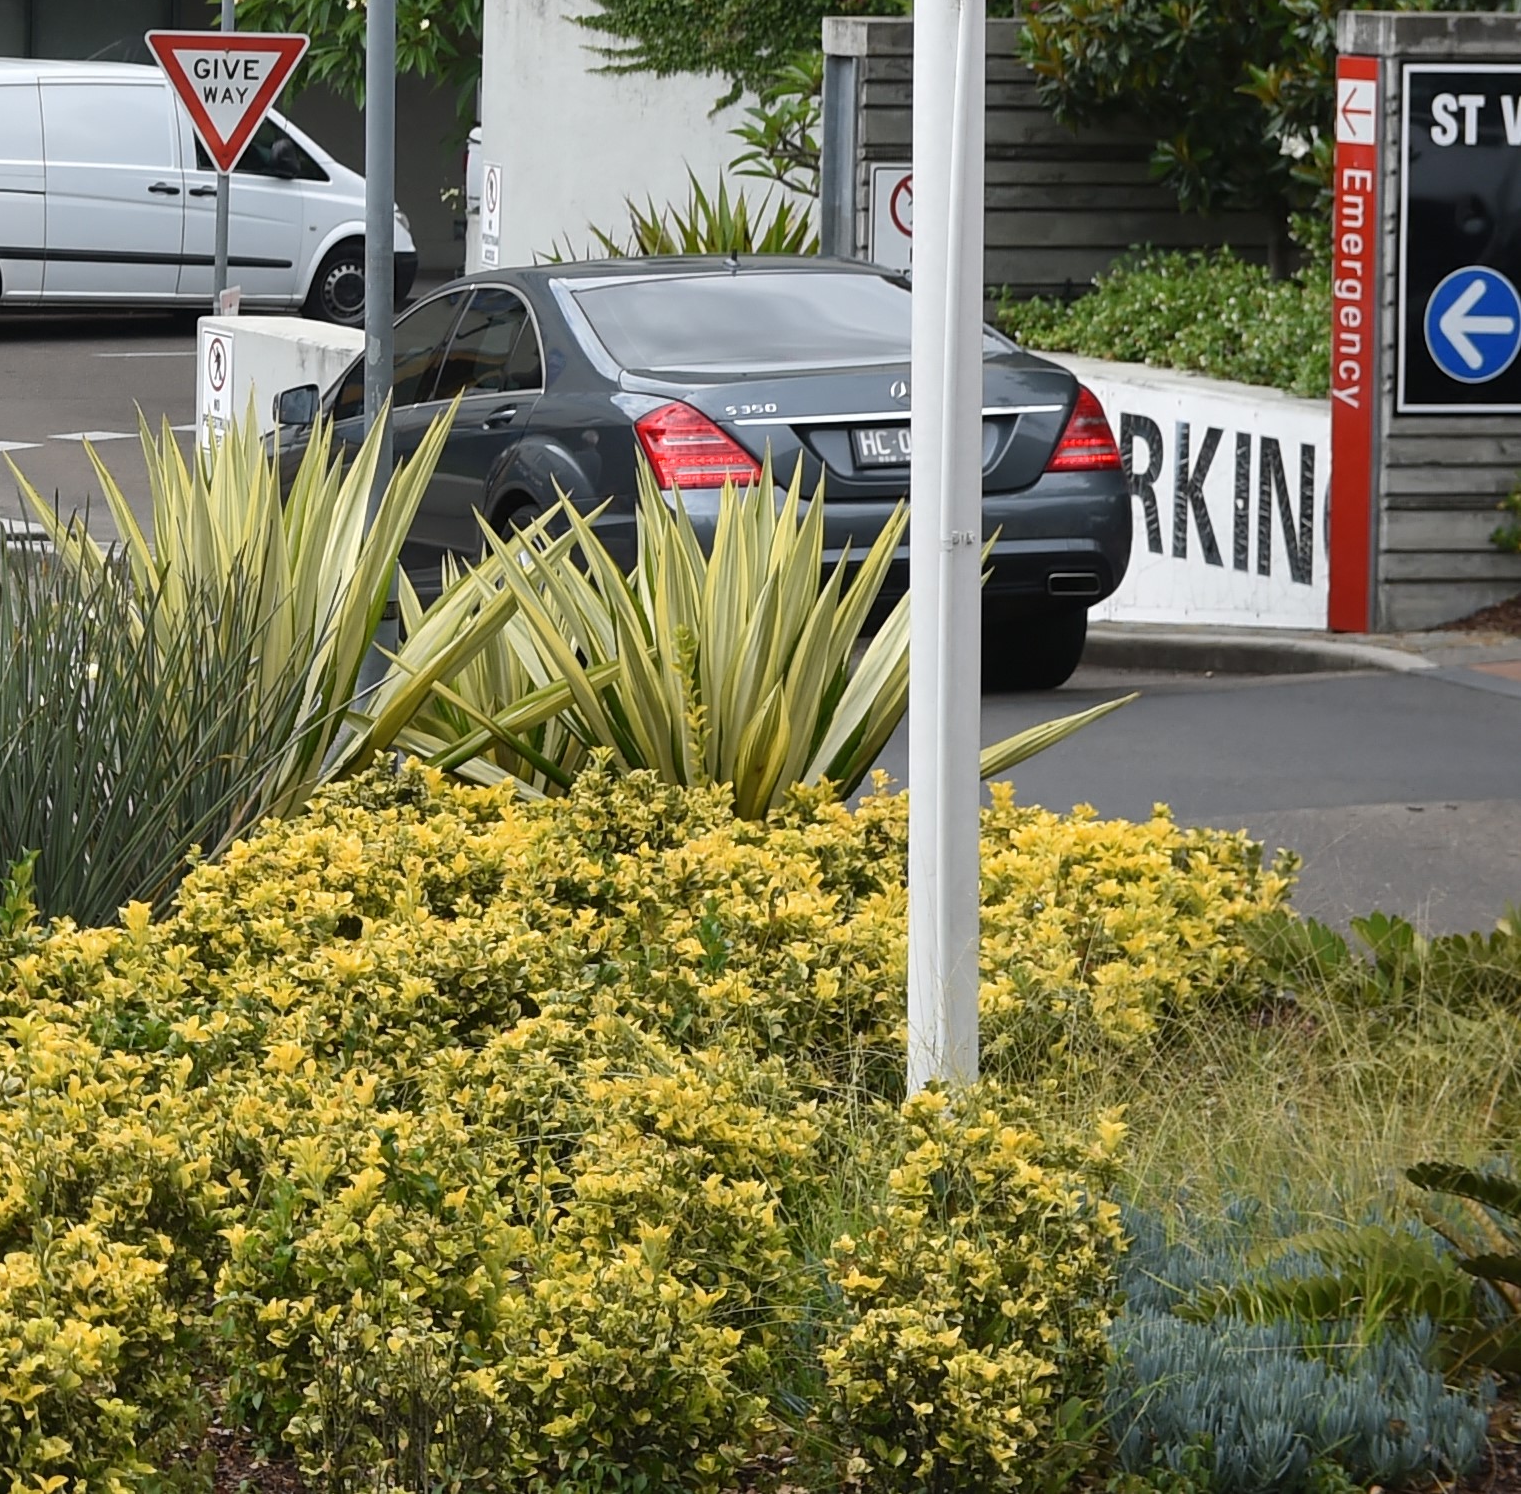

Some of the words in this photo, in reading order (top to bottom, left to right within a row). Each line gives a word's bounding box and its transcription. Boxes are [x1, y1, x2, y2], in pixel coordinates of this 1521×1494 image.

[193, 58, 260, 80] GIVE
[203, 86, 249, 104] WAY
[1430, 92, 1486, 147] ST
[1332, 168, 1372, 409] Emergency
[1120, 411, 1330, 586] RKIN
